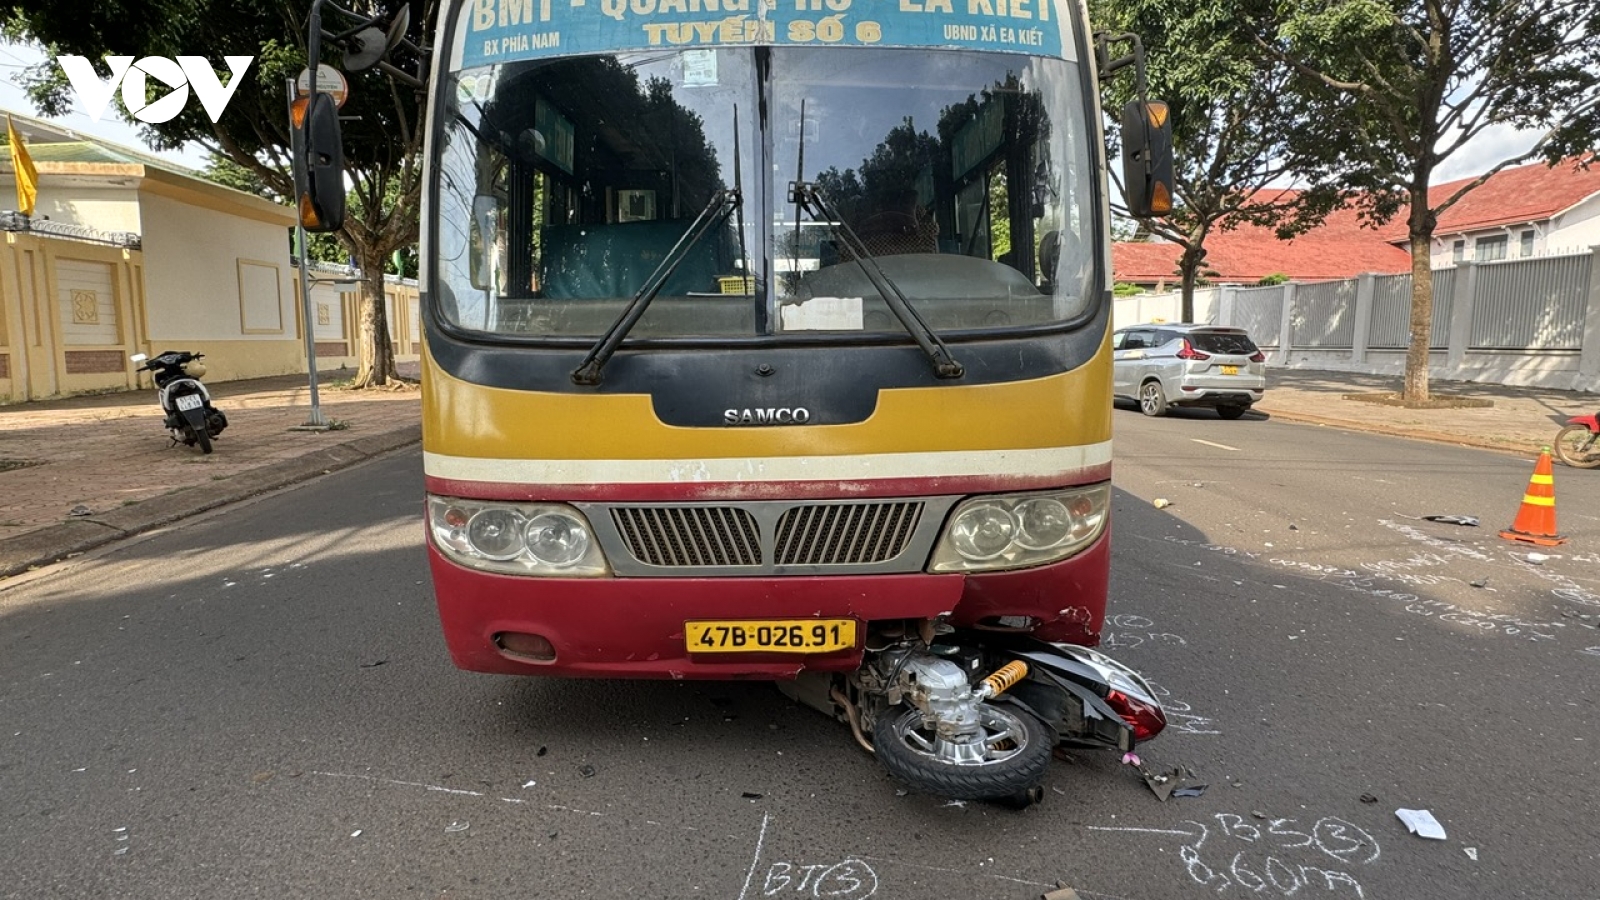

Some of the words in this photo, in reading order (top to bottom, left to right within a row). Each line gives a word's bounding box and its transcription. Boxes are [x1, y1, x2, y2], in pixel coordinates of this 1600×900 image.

[787, 13, 848, 43] SỐ
[855, 20, 882, 43] 6
[943, 24, 977, 42] UBND
[980, 23, 998, 42] XÃ
[1000, 28, 1016, 44] EA
[483, 38, 499, 57] BX
[501, 32, 529, 54] PHÍA
[531, 31, 560, 51] NAM
[724, 407, 810, 426] SAMCO
[700, 625, 840, 648] 47B-026.91
